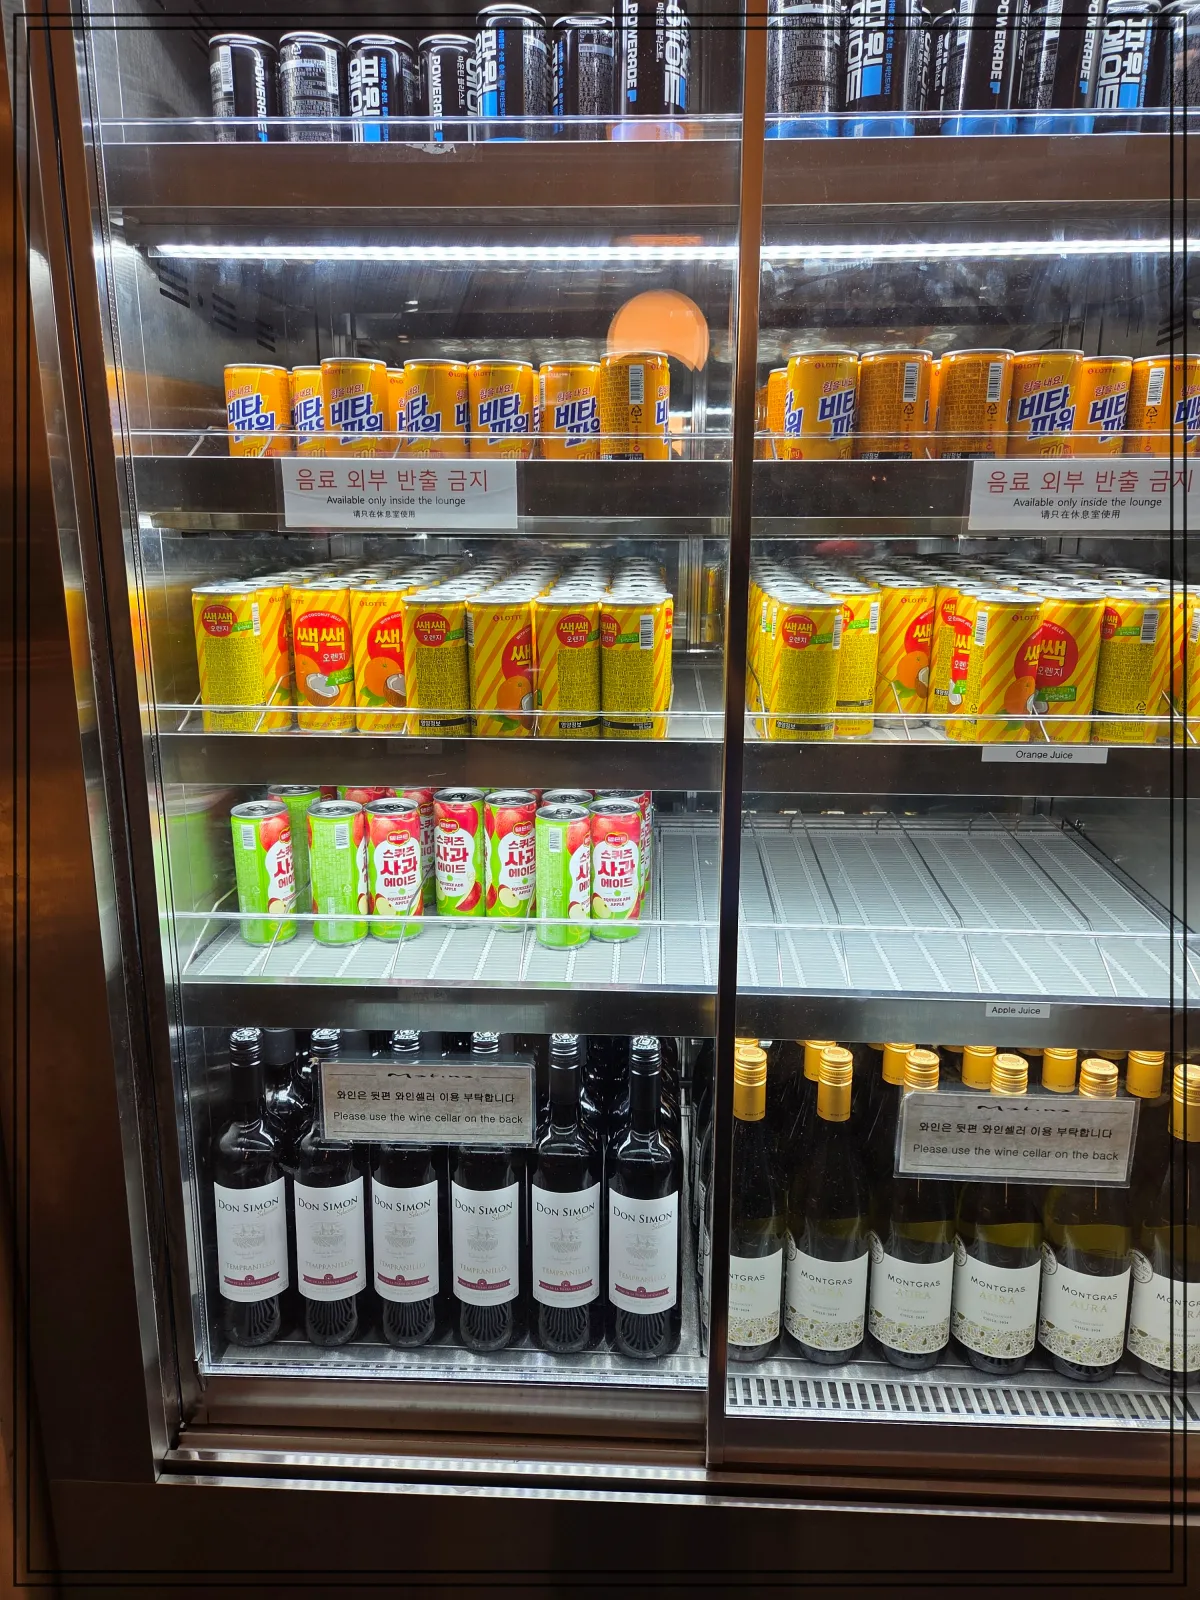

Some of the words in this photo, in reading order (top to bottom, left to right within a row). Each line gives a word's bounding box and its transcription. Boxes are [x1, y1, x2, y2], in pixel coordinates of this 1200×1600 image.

[627, 3, 638, 89] POWERADE
[1121, 18, 1147, 83] 파워
[482, 29, 497, 92] 파워
[361, 56, 381, 116] 파워
[432, 55, 443, 131] POWERAE
[254, 57, 268, 132] POWERAE
[228, 394, 262, 424] 비타
[330, 393, 374, 426] 비타
[478, 393, 521, 428] 비타
[1017, 384, 1070, 422] 비타
[554, 396, 597, 430] 비타
[1027, 405, 1076, 440] 파워
[296, 468, 338, 492] 음료
[347, 469, 388, 492] 외부
[397, 469, 438, 492] 반출
[448, 469, 488, 492] 금지
[986, 470, 1031, 494] 음료
[1040, 470, 1085, 494] 외부
[1096, 470, 1139, 494] 반출
[1149, 470, 1194, 492] 금지
[326, 496, 365, 506] Available
[368, 496, 386, 507] only
[390, 496, 415, 505] inside
[418, 496, 432, 505] the
[436, 496, 466, 508] lounge
[1012, 497, 1054, 507] Available
[1057, 498, 1078, 509] only
[1080, 497, 1108, 507] inside
[1111, 498, 1126, 507] the
[1129, 498, 1162, 508] lounge
[353, 510, 416, 518] 请只在休息室使用
[1040, 510, 1120, 519] 请只在休息室使用
[416, 620, 446, 634] 쌕쌕
[560, 622, 588, 634] 쌕쌕
[784, 622, 813, 634] 쌕쌕
[296, 627, 345, 652] 쌕쌕
[322, 652, 346, 662] 오렌지
[1016, 750, 1048, 760] Orange
[1050, 750, 1074, 760] Juice
[436, 835, 464, 846] 스퀴즈
[382, 846, 416, 859] 스퀴즈
[436, 846, 470, 863] 사과
[600, 849, 632, 860] 스퀴즈
[380, 858, 418, 876] 사과
[438, 864, 466, 874] 에이드
[597, 860, 636, 877] 사과
[384, 874, 416, 888] 에이드
[600, 878, 634, 888] 에이드
[336, 1090, 368, 1100] 와인은
[370, 1091, 392, 1101] 뒷편
[395, 1091, 436, 1102] 와인셀러
[440, 1092, 460, 1102] 이용
[464, 1092, 515, 1104] 부탁합니다
[333, 1112, 366, 1121] Please
[390, 1113, 406, 1122] the
[408, 1114, 431, 1122] wine
[434, 1114, 461, 1122] cellar
[480, 1114, 496, 1124] the
[499, 1114, 523, 1124] back
[918, 1122, 952, 1134] 와인은
[956, 1124, 977, 1134] 뒷편
[982, 1124, 1026, 1136] 와인셀러
[1030, 1126, 1052, 1136] 이용
[1056, 1127, 1113, 1138] 부탁합니다
[913, 1144, 948, 1154] Please
[974, 1146, 991, 1156] the
[994, 1148, 1018, 1157] wine
[1022, 1148, 1051, 1158] cellar
[1054, 1152, 1068, 1160] on
[1072, 1150, 1088, 1160] the
[1092, 1151, 1119, 1160] back
[218, 1198, 240, 1212] DON
[243, 1196, 280, 1212] SIMON
[298, 1198, 320, 1211] DON
[322, 1196, 358, 1211] SIMON
[374, 1194, 393, 1211] DON
[396, 1199, 431, 1212] SIMON
[455, 1198, 476, 1214] DON
[478, 1202, 513, 1215] SIMON
[536, 1202, 559, 1216] DON
[562, 1202, 595, 1216] SIMON
[613, 1206, 636, 1222] DON
[638, 1210, 672, 1224] SIMON
[800, 1270, 853, 1286] MONTGRAS
[888, 1273, 941, 1288] MONTGRAS
[970, 1275, 1026, 1293] MONTGRAS
[1062, 1284, 1118, 1301] MONTGRAS
